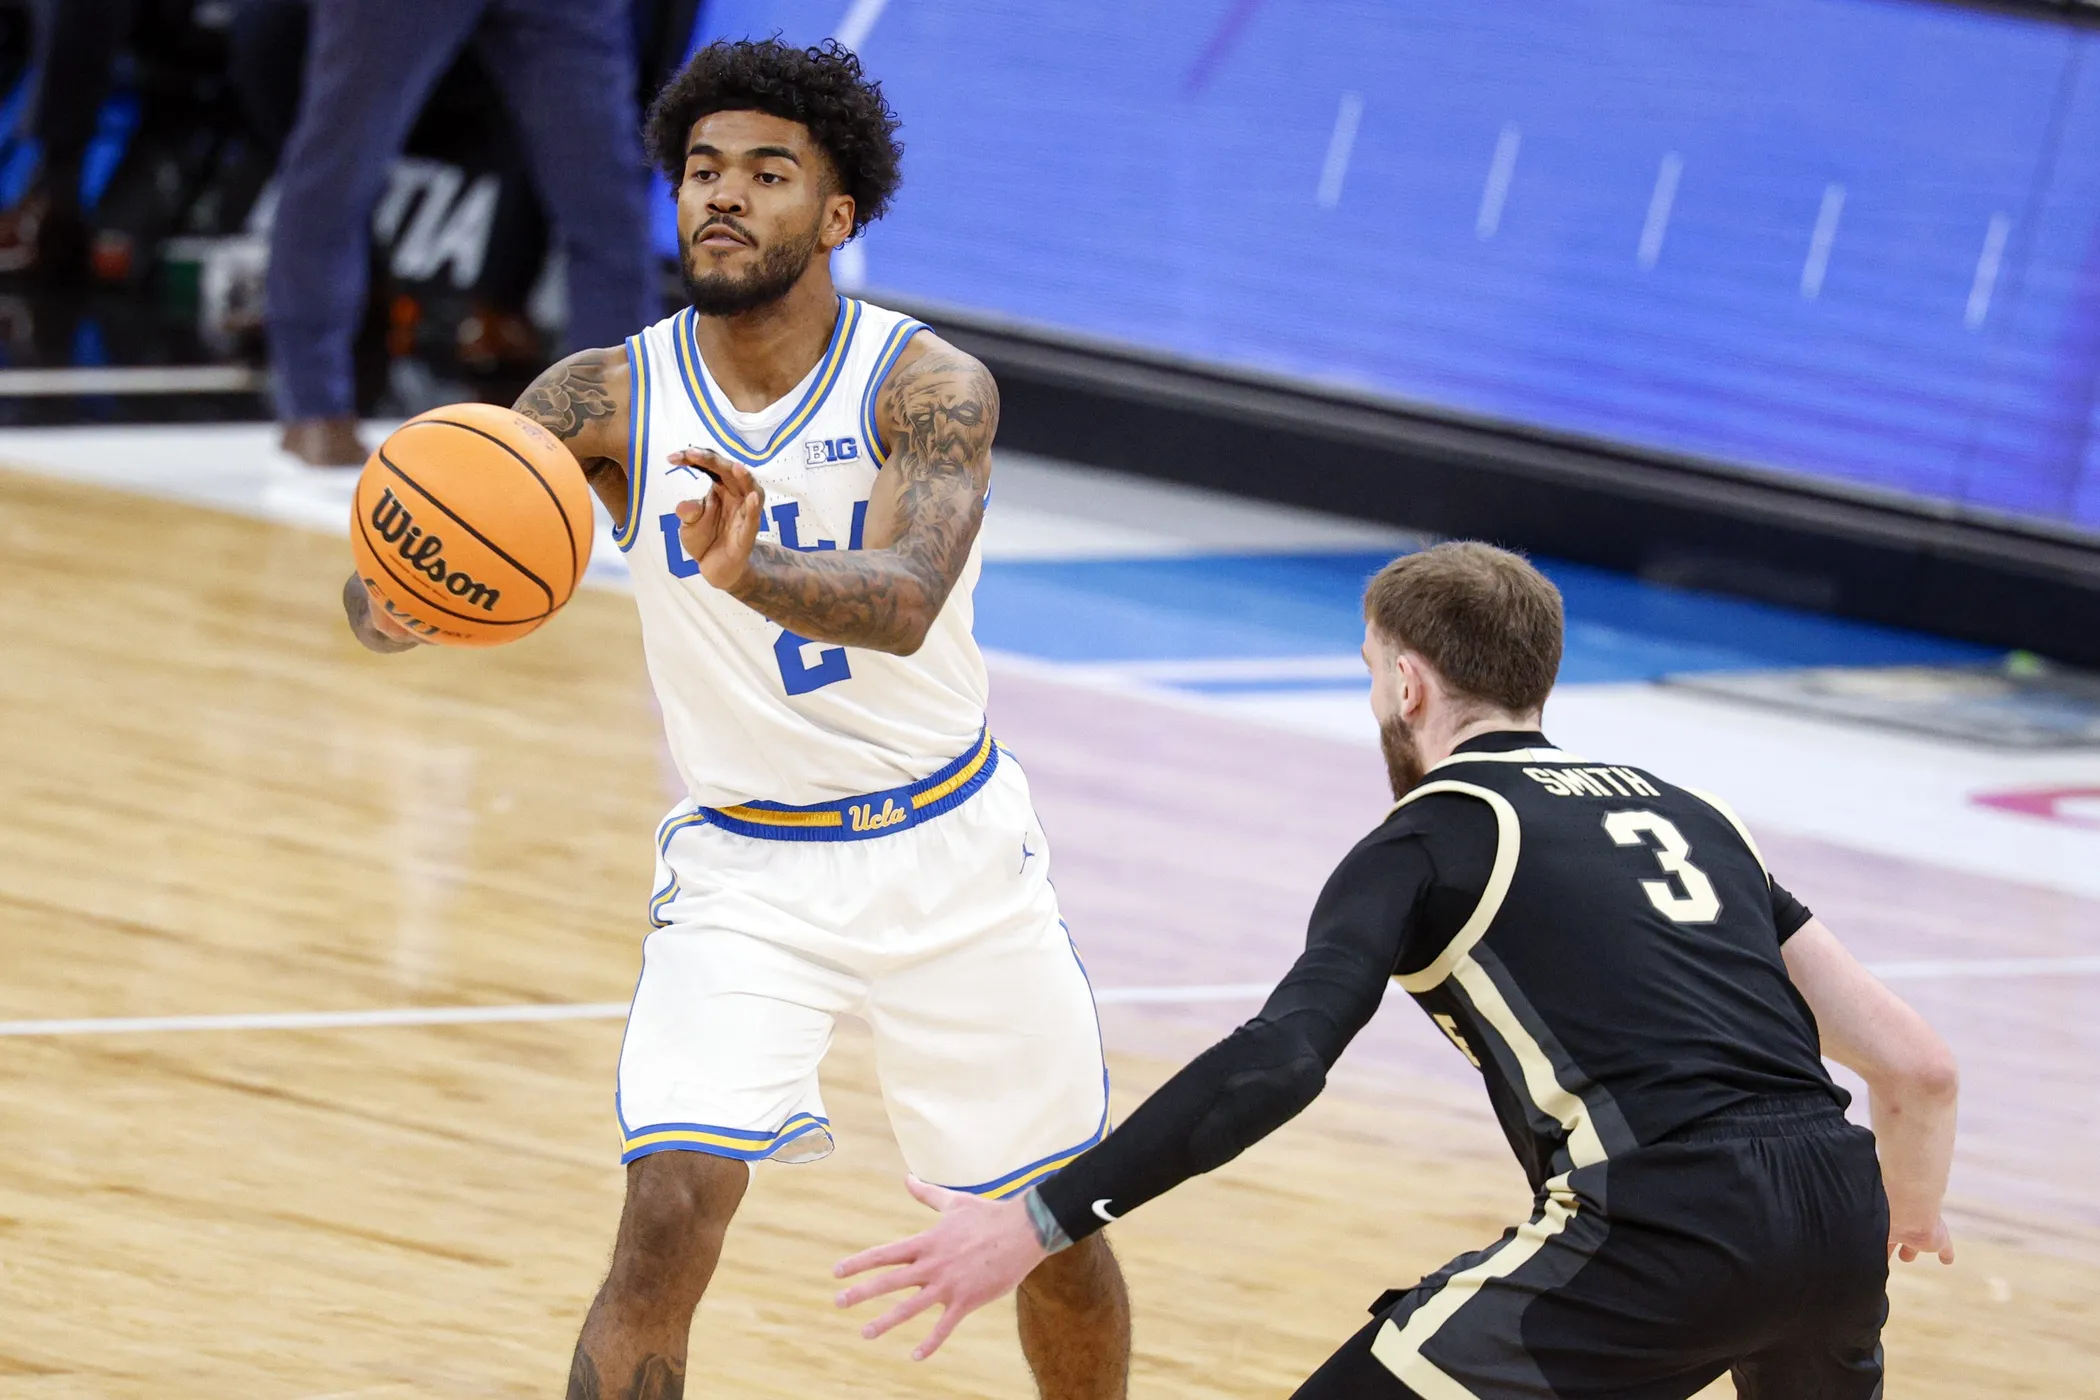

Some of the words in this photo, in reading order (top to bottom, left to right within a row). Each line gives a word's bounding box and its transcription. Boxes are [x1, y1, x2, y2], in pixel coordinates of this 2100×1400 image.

[371, 484, 501, 612] Wilson
[848, 798, 907, 832] Ucla
[1522, 766, 1662, 798] SMITH
[1601, 808, 1724, 925] 3
